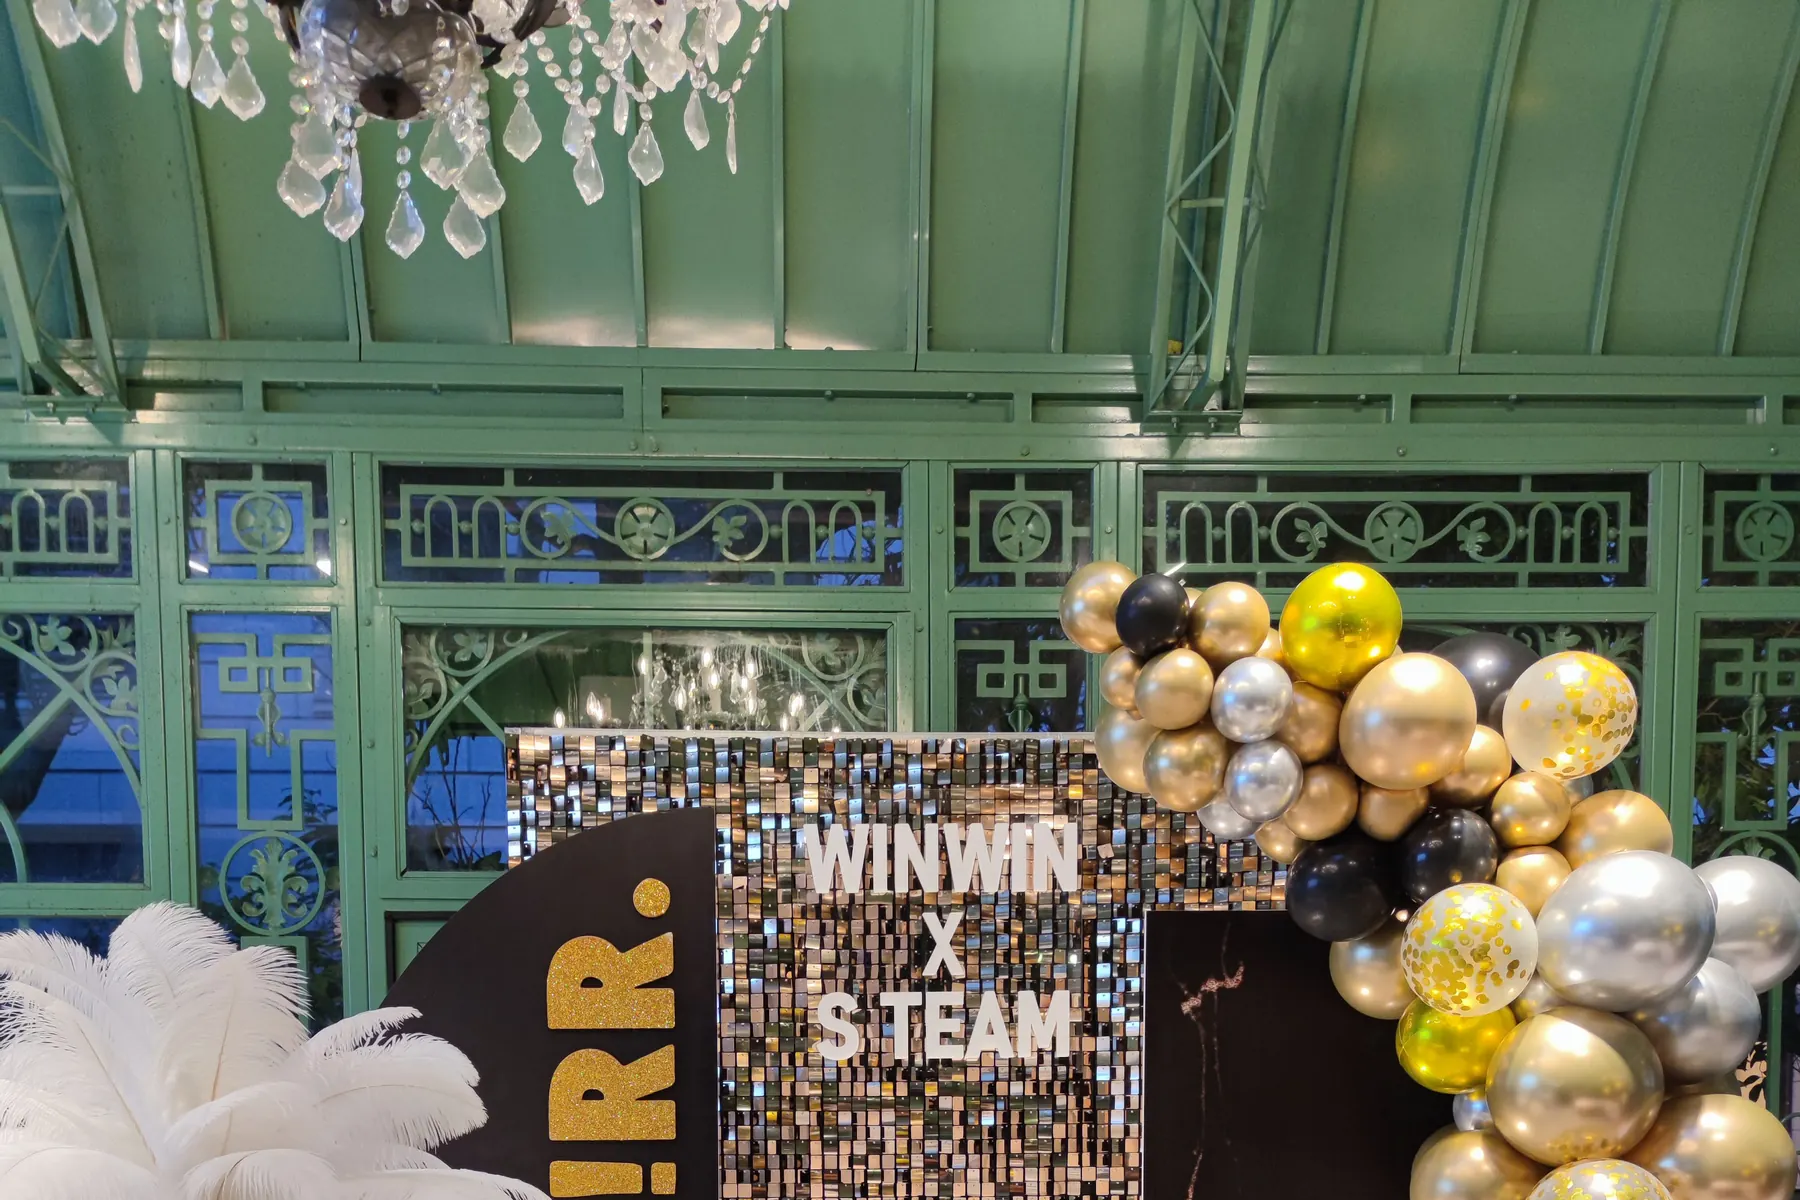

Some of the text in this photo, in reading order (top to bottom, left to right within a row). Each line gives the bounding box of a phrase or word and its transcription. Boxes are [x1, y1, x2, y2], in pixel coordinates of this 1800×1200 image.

[803, 823, 1077, 893] WINWIN
[922, 912, 965, 977] X
[816, 990, 1071, 1061] S TEAM
